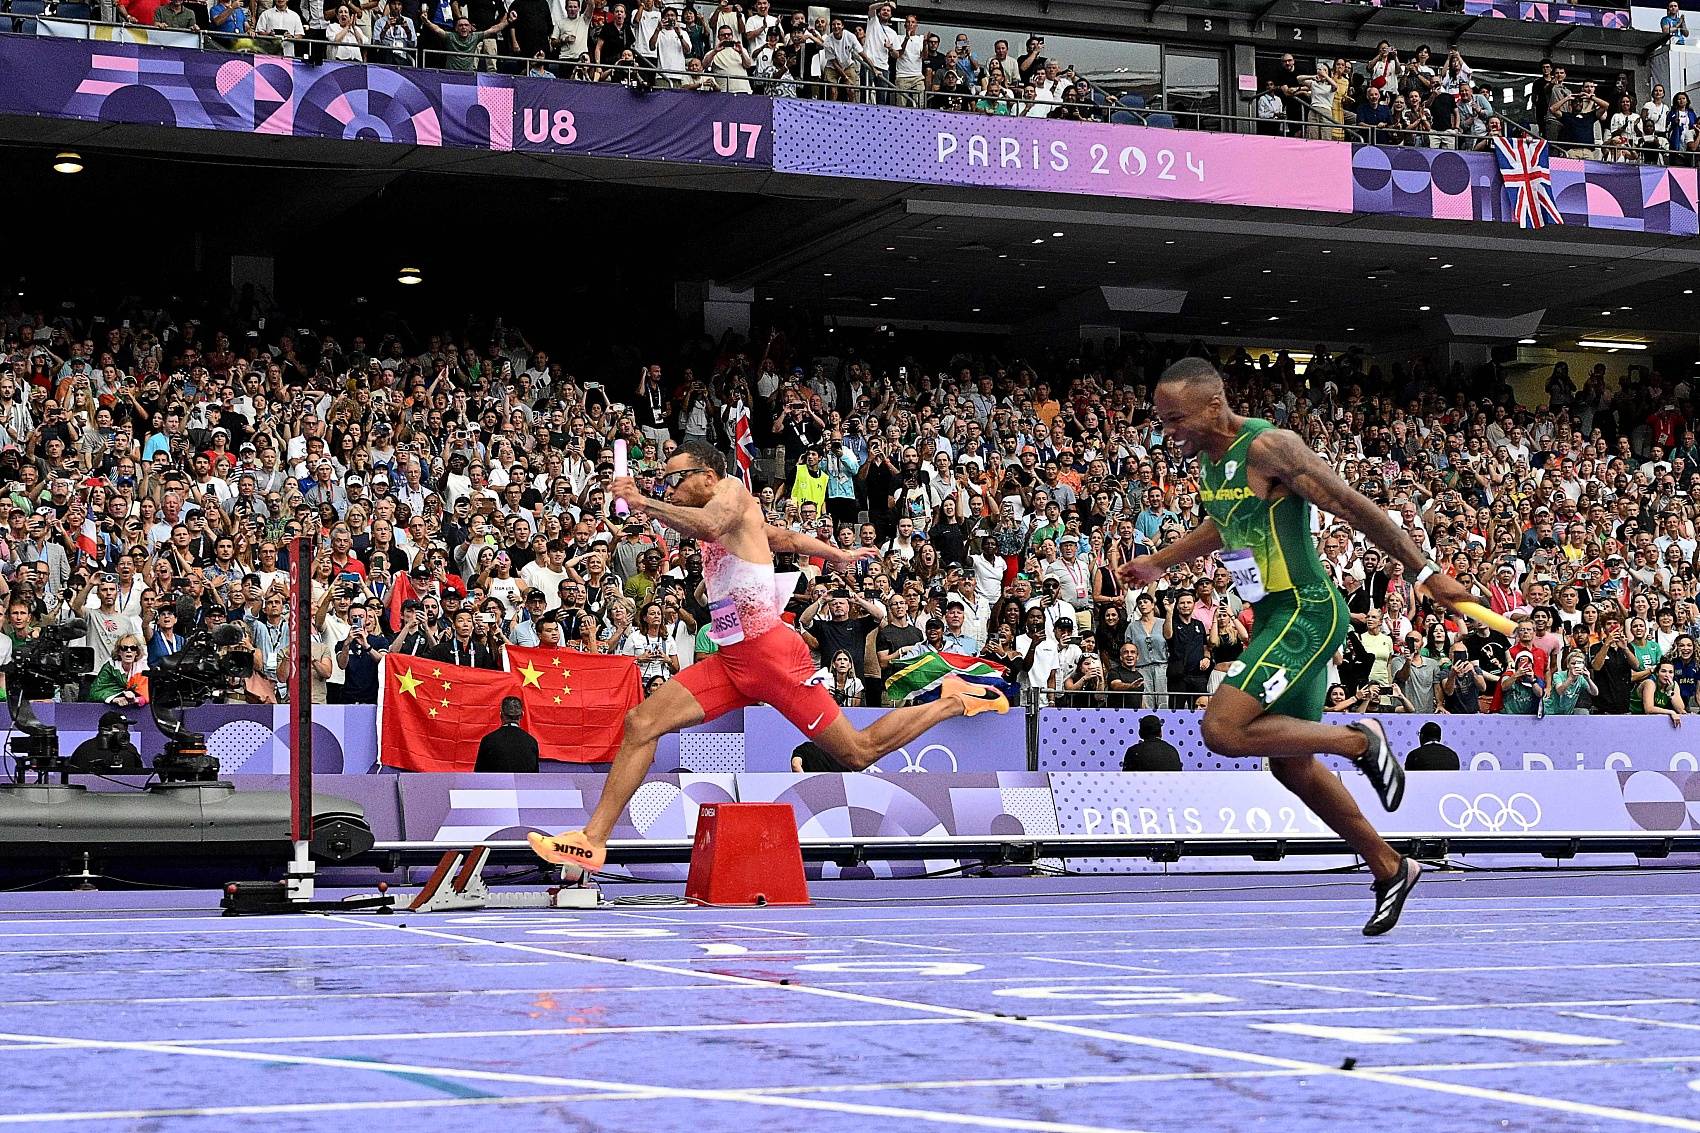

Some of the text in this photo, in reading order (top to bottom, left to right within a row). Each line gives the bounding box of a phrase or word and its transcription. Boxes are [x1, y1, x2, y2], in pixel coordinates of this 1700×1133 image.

[1204, 19, 1213, 31] 3
[1293, 28, 1302, 40] 2
[523, 108, 577, 145] U8
[712, 121, 762, 158] U7
[1090, 143, 1204, 182] 2024
[553, 842, 593, 859] NITRO
